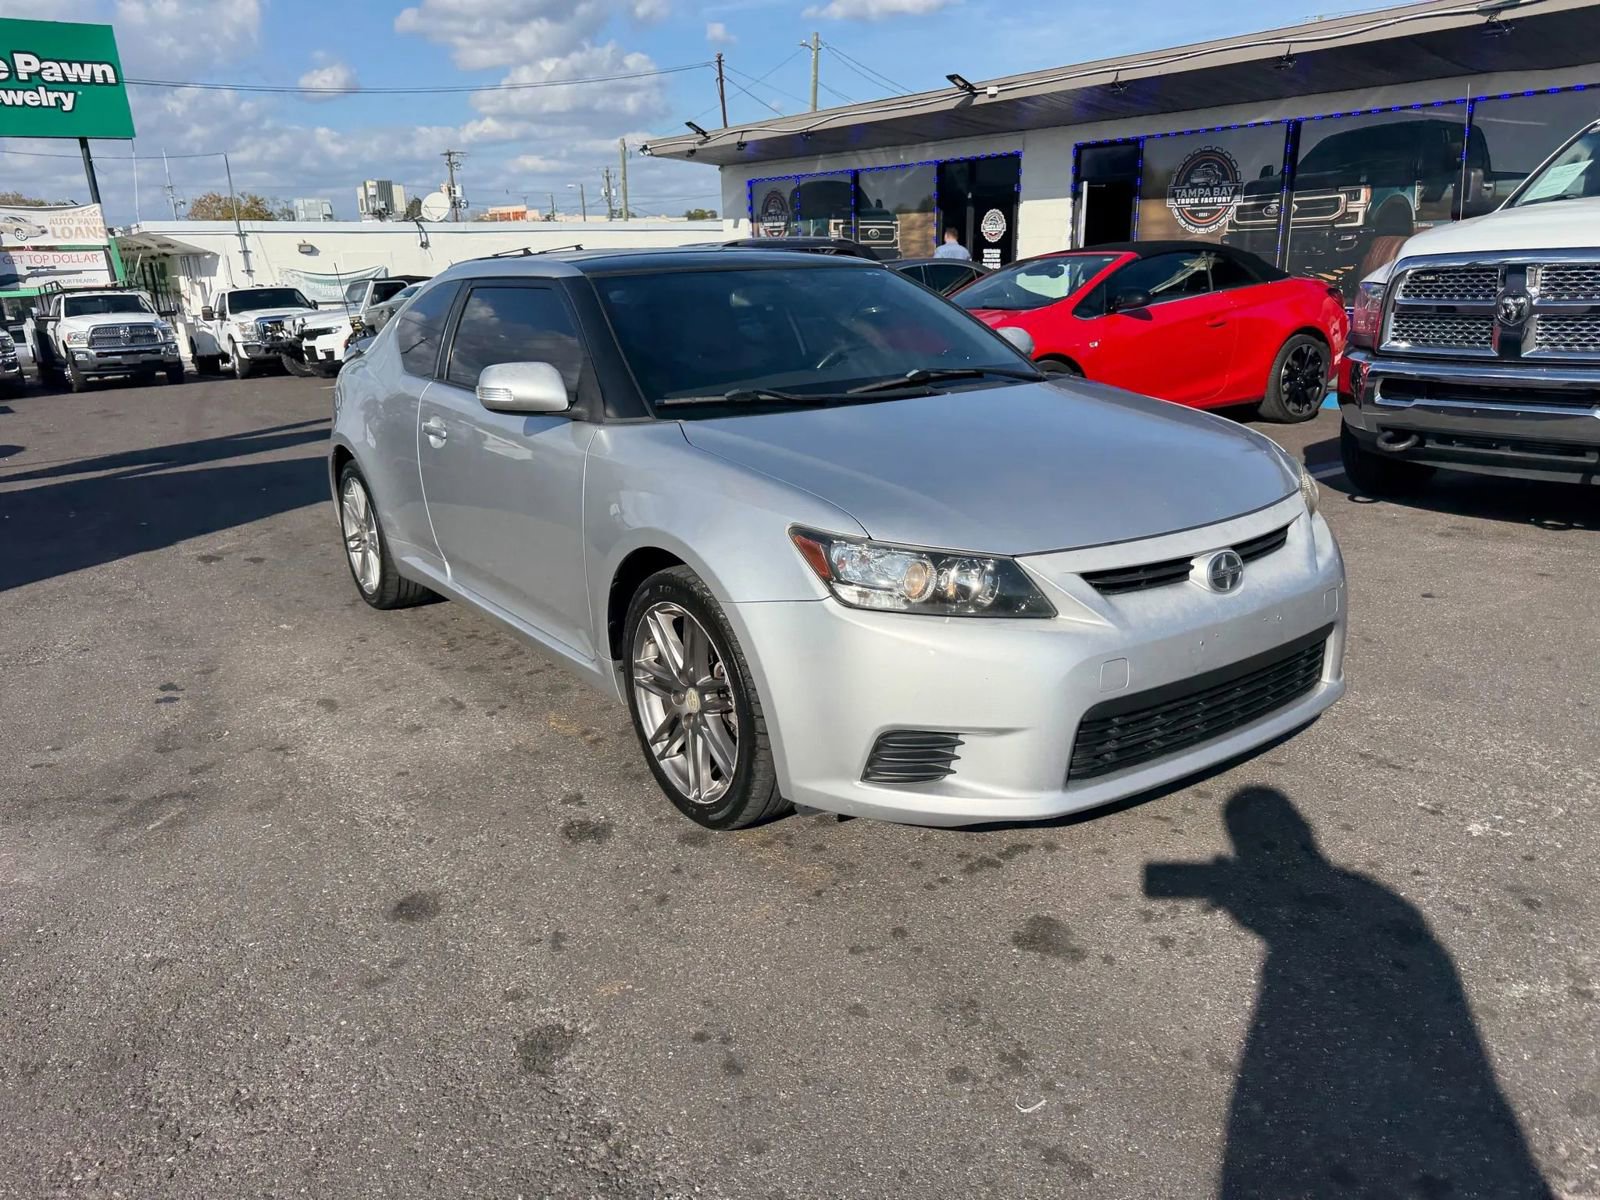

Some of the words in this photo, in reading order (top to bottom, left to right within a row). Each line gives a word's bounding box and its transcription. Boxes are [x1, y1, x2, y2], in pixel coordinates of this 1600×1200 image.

[13, 53, 116, 83] Pawn
[0, 86, 75, 111] welry
[1175, 188, 1211, 198] TAMPA
[1213, 186, 1235, 196] BAY
[49, 217, 74, 225] AUTO
[51, 226, 106, 239] LOANS
[3, 255, 24, 264] GET
[26, 254, 49, 264] TOP
[52, 253, 98, 264] DOLLAR
